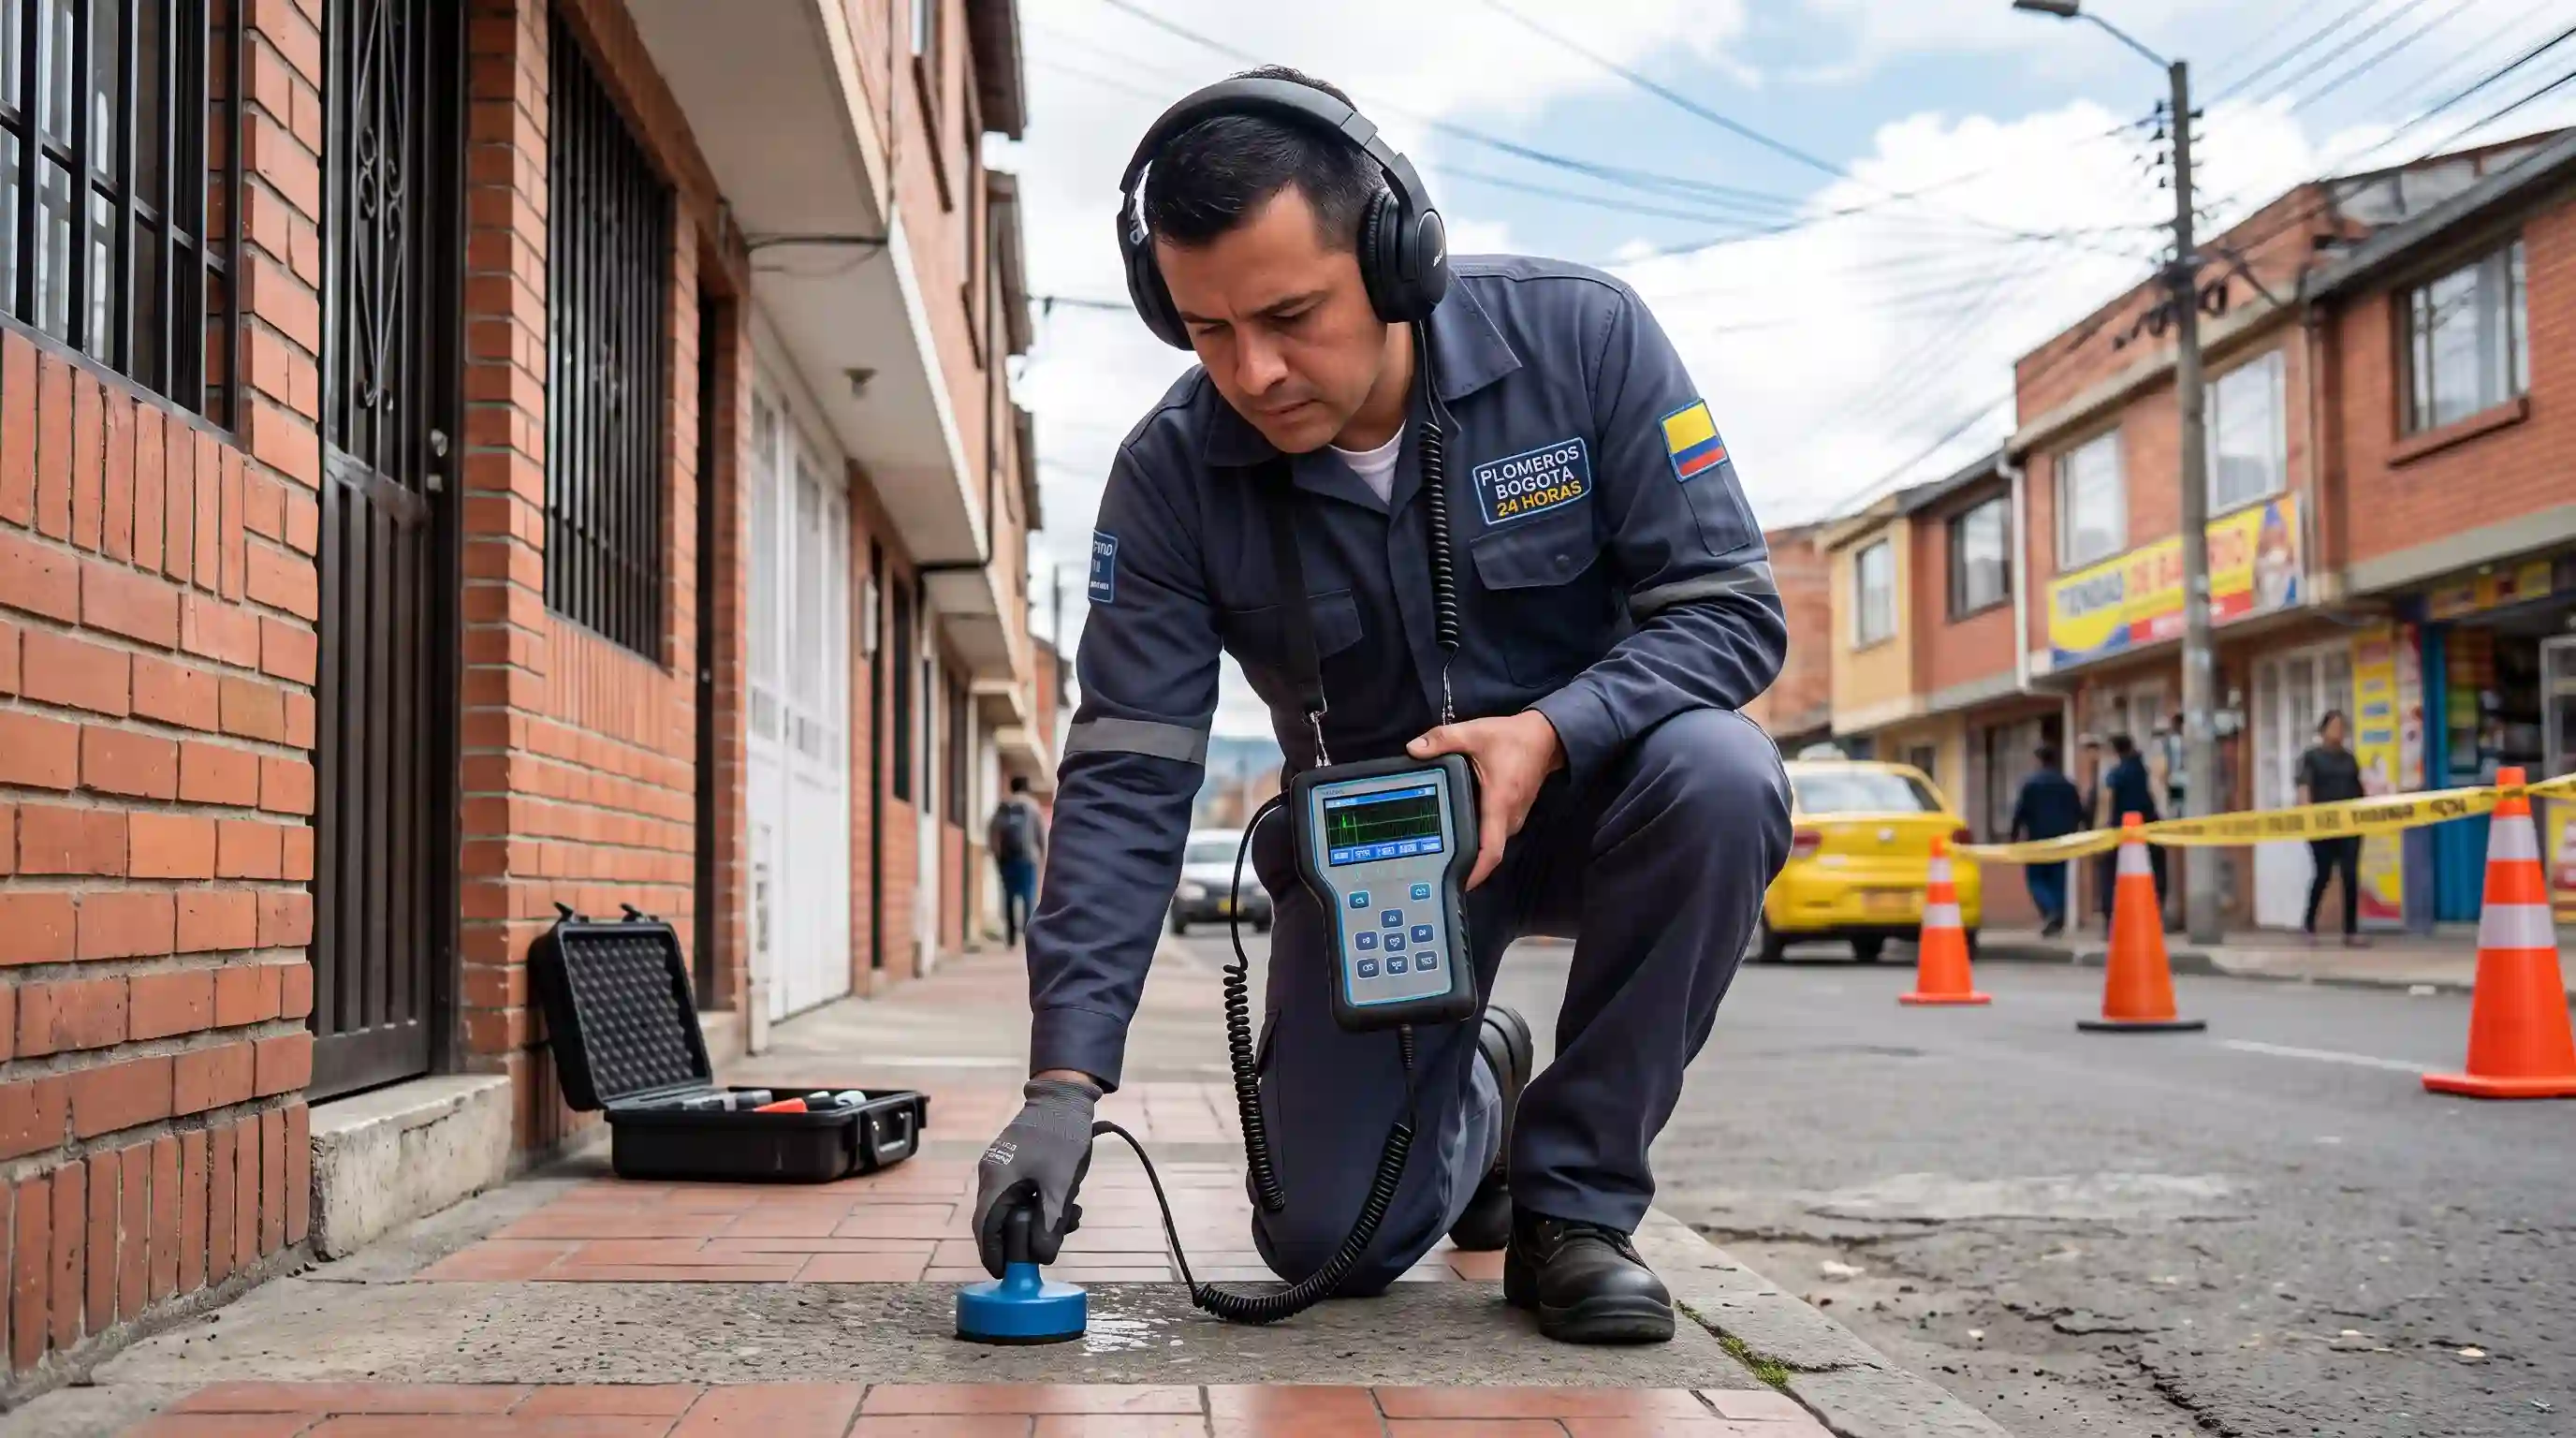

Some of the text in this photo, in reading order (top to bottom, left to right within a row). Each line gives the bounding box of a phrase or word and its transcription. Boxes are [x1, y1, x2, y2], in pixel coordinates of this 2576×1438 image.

[1480, 446, 1579, 487] PLOMEROS
[1495, 466, 1575, 500] BOGOTA
[1498, 480, 1582, 517] 24 HORAS
